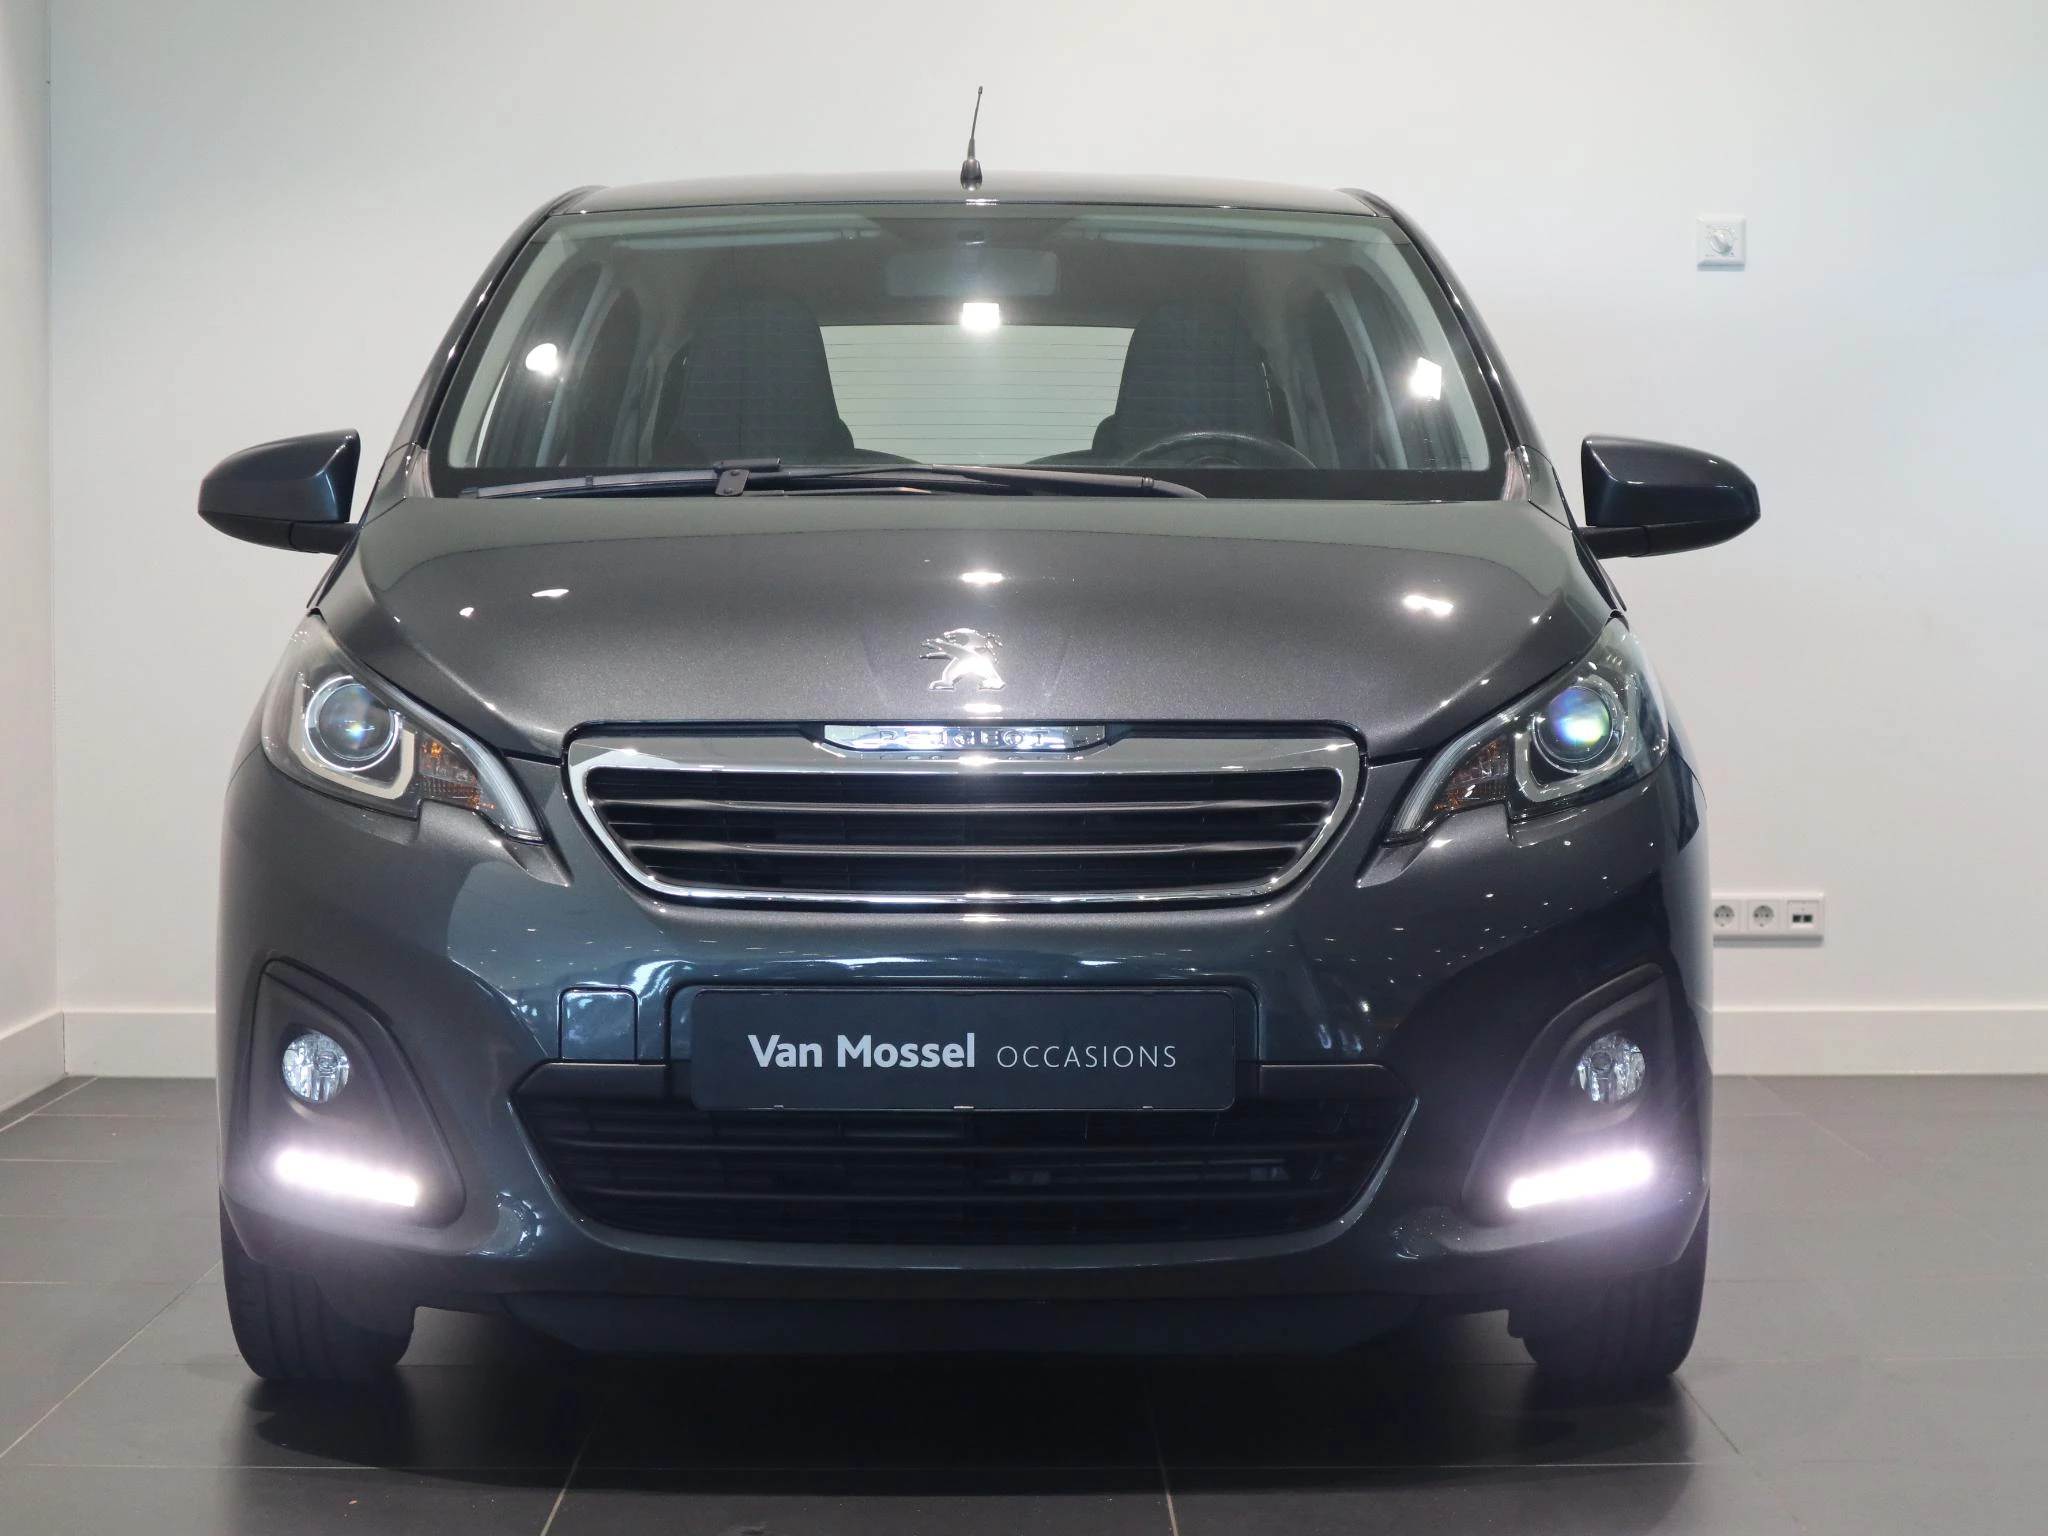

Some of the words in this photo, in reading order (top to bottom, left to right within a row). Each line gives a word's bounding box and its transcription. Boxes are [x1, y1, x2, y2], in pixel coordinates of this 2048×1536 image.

[747, 1034, 822, 1067] Van
[837, 1032, 975, 1067] Mossel
[996, 1045, 1176, 1068] OCCASIONS
